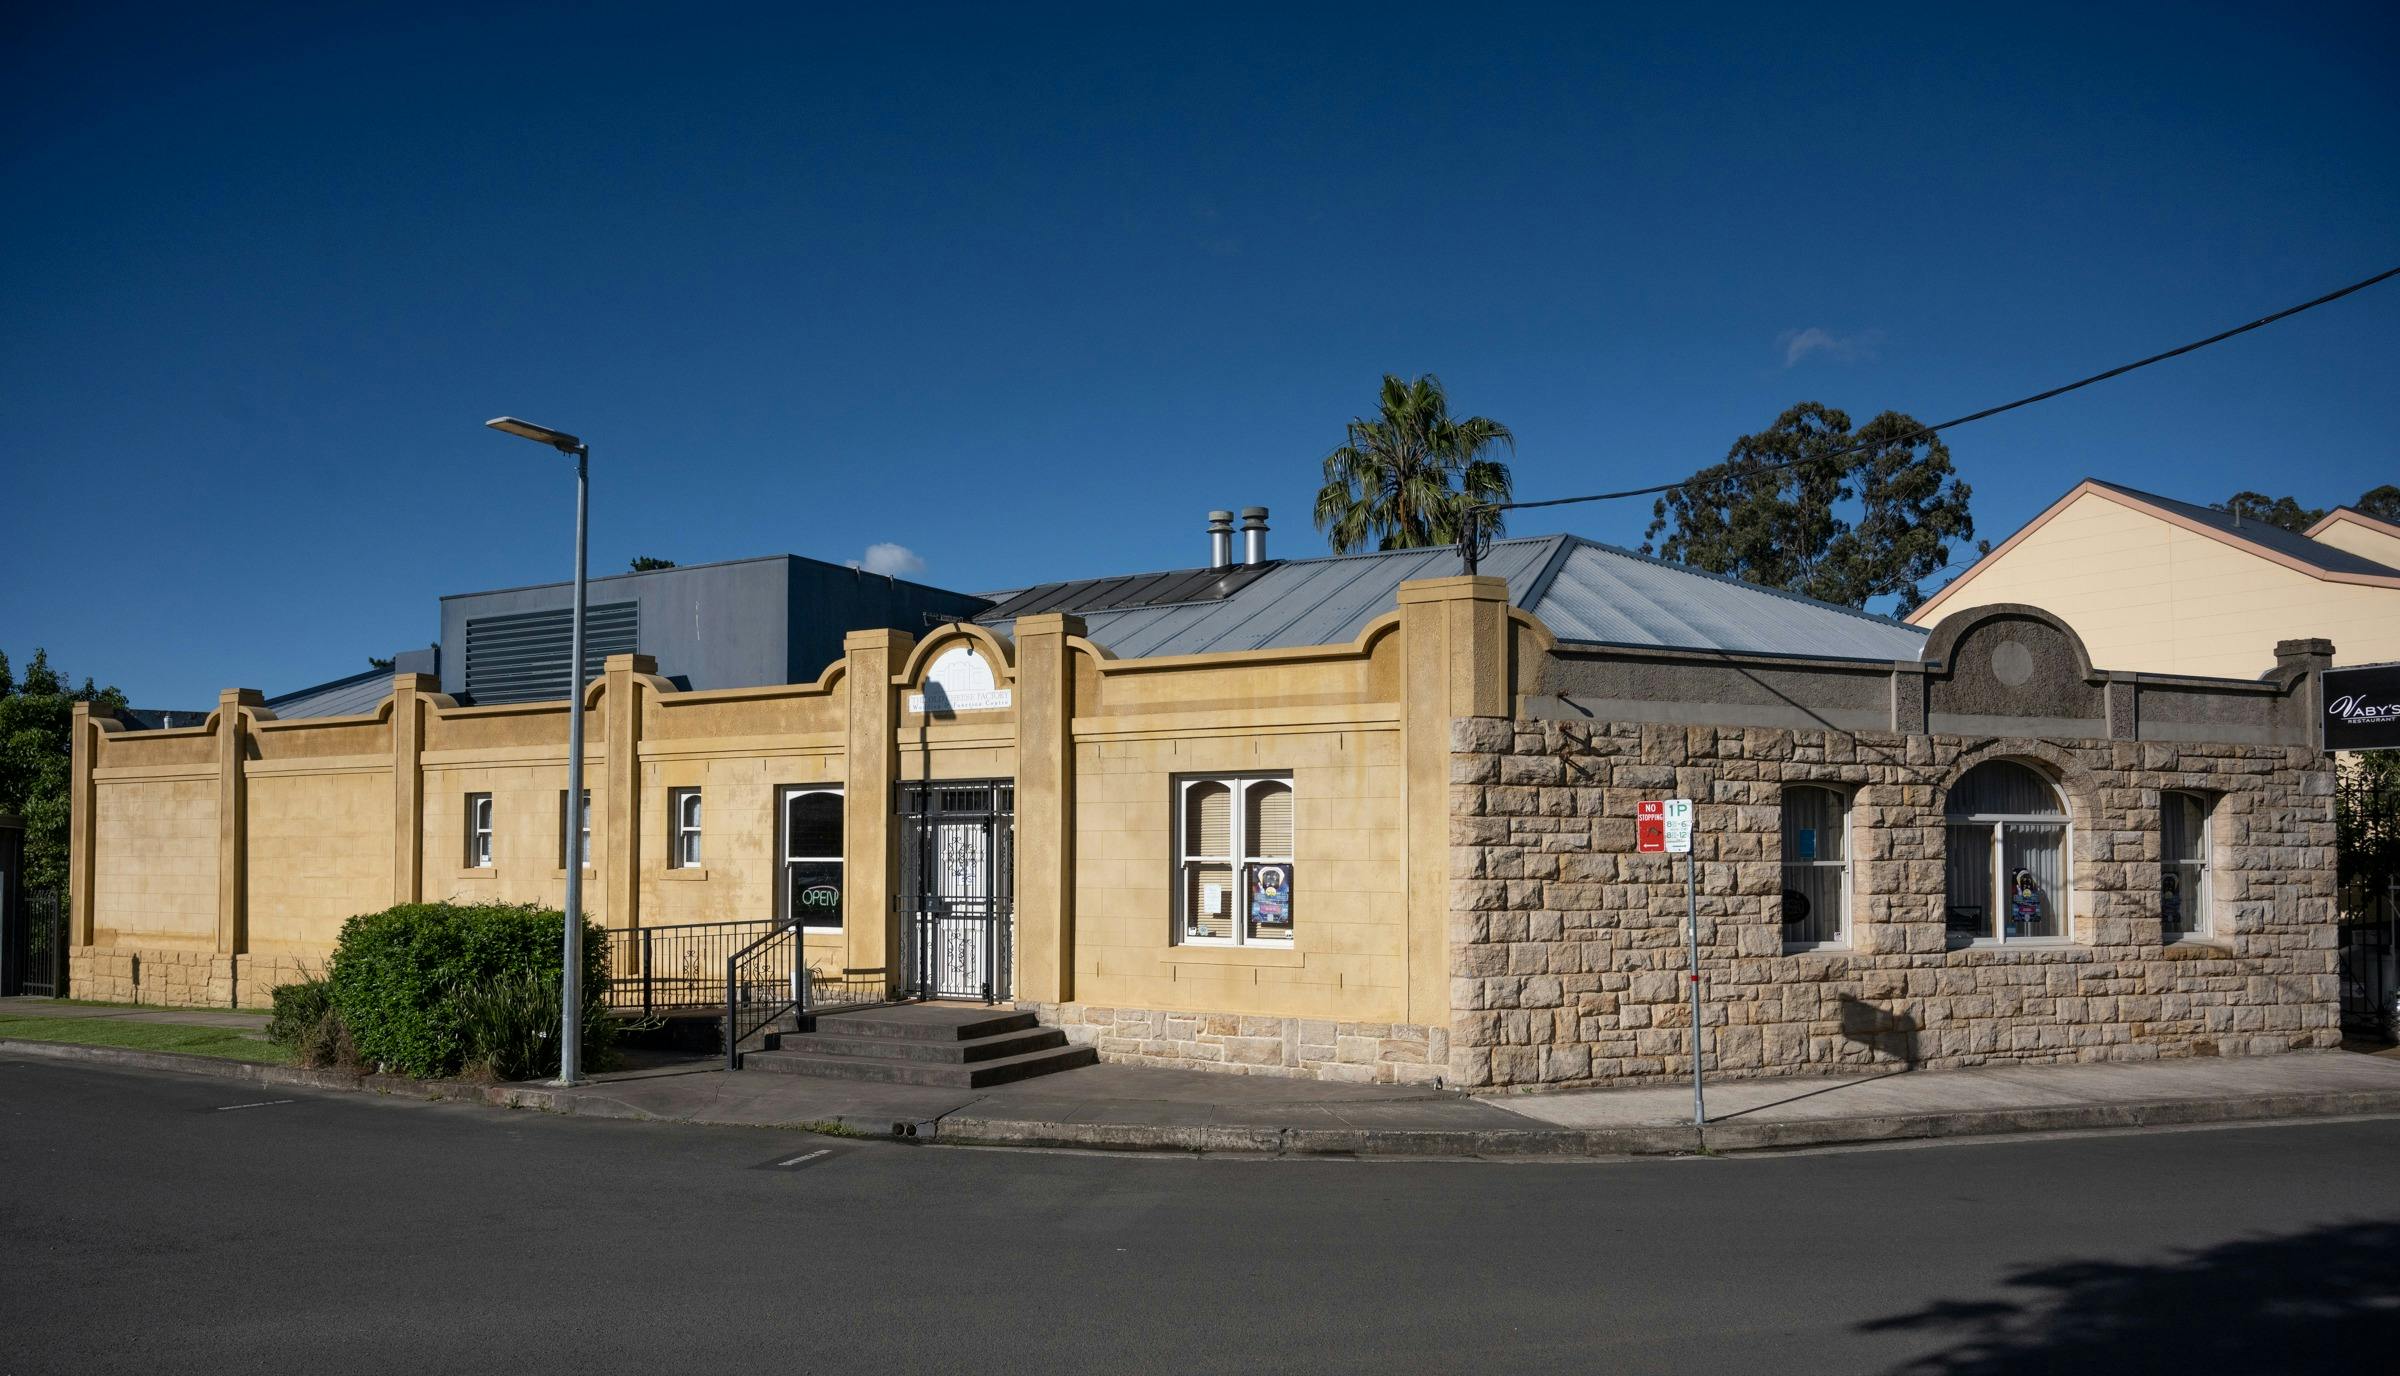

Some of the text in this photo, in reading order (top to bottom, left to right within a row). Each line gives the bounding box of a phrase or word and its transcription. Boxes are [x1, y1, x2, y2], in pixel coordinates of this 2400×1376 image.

[1645, 803, 1656, 812] NO
[1669, 804, 1687, 817] 1P
[1639, 813, 1663, 821] STOPPING
[802, 889, 836, 906] OPEN
